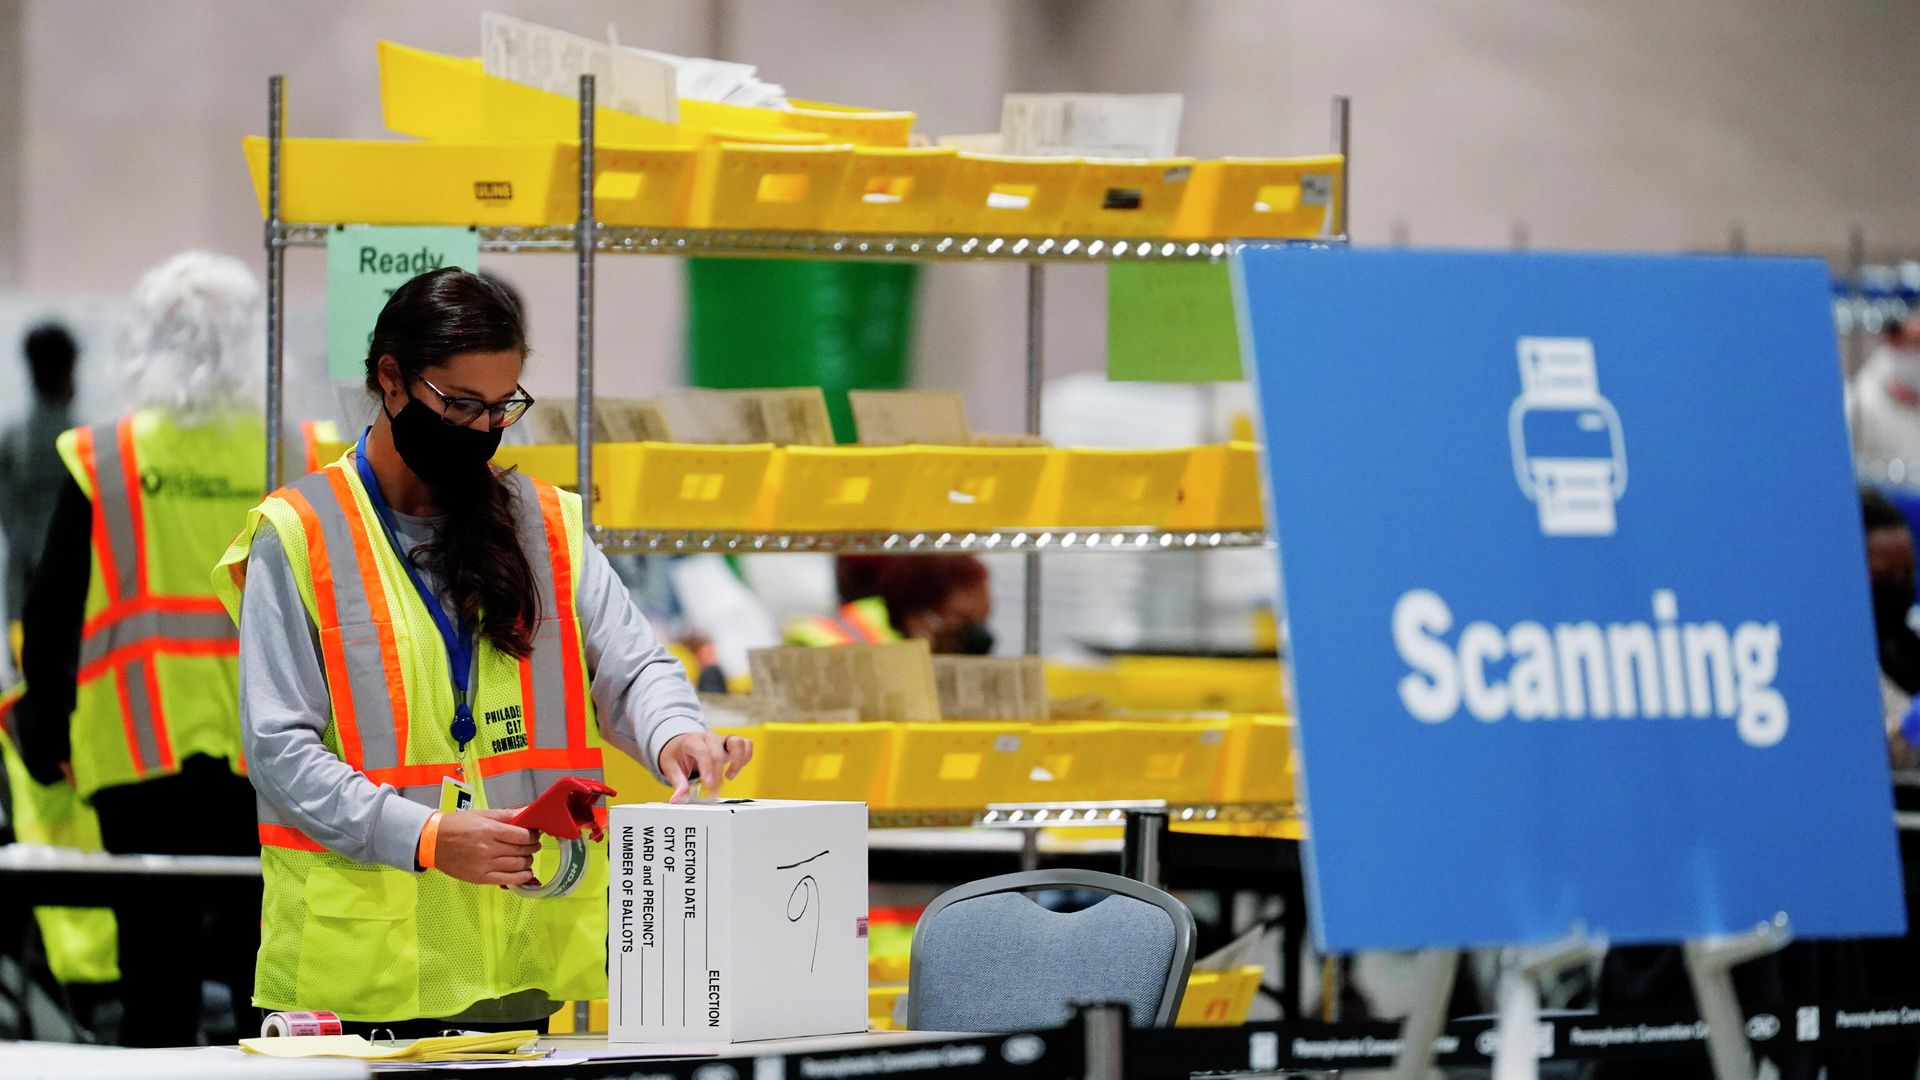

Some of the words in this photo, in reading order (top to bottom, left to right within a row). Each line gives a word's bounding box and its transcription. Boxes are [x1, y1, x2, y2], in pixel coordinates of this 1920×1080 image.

[359, 246, 444, 274] Ready
[1392, 588, 1789, 748] Scanning
[485, 704, 522, 725] PHILADE
[622, 826, 634, 876] NUMBER
[642, 826, 654, 862] WARD
[663, 826, 675, 853] CITY
[684, 826, 696, 884] ELECTION
[642, 865, 654, 886] and
[663, 856, 675, 872] OF
[622, 879, 633, 896] OF
[684, 888, 696, 919] DATE
[621, 899, 633, 953] BALLOTS
[642, 889, 654, 948] PRECINCT
[708, 970, 720, 1027] ELECTION
